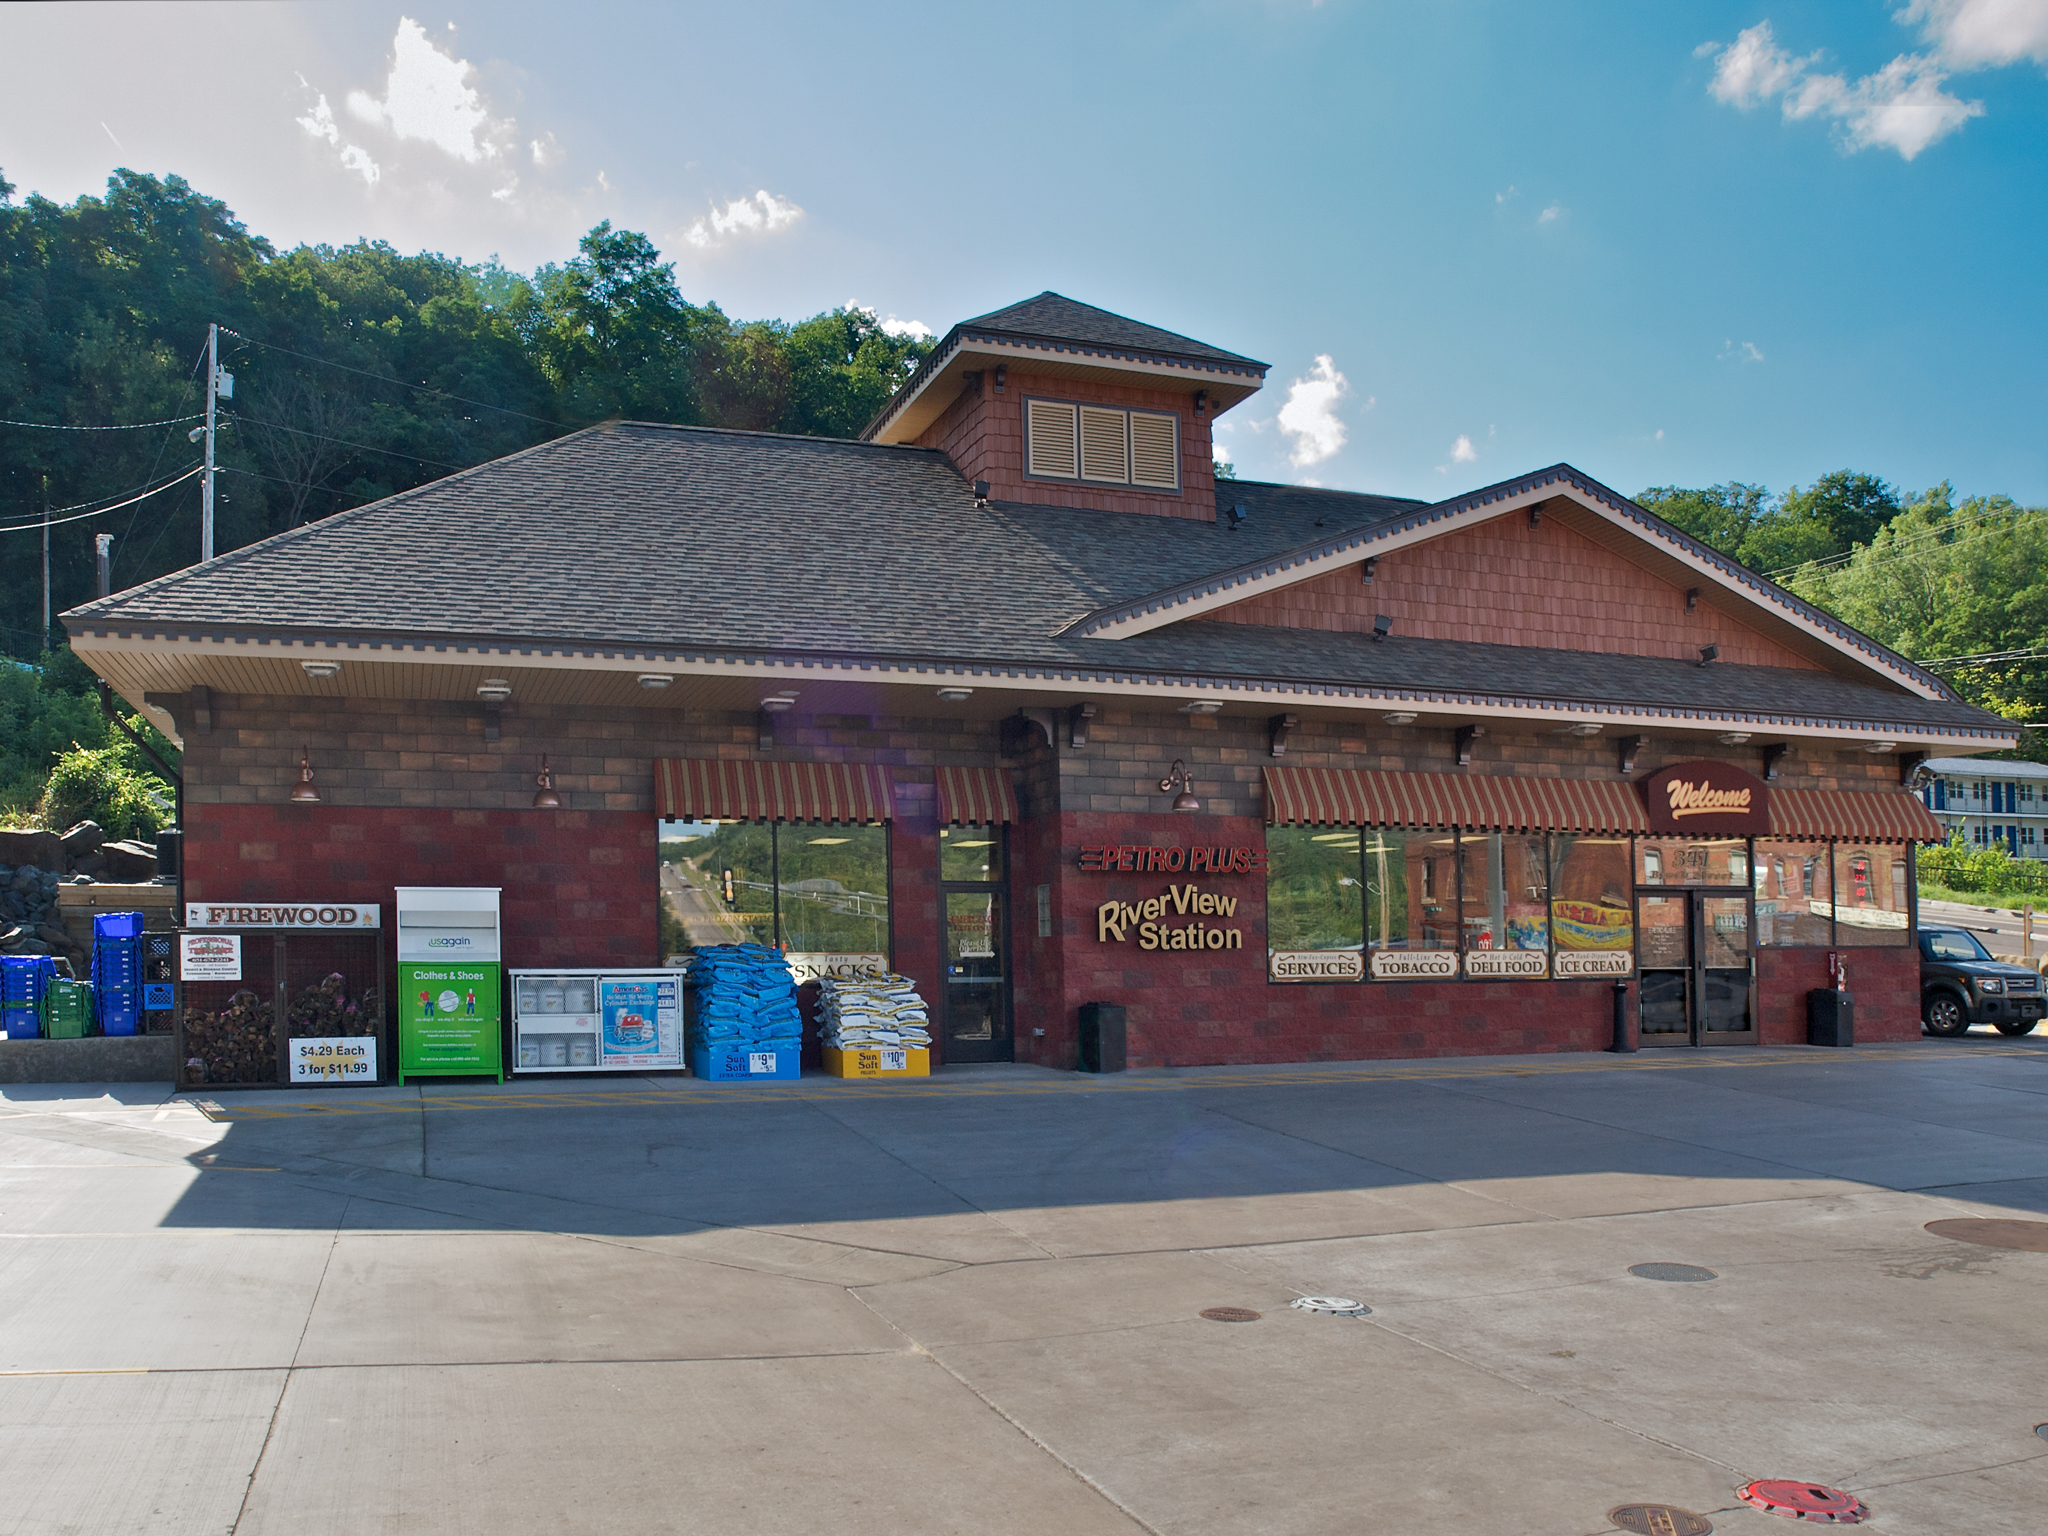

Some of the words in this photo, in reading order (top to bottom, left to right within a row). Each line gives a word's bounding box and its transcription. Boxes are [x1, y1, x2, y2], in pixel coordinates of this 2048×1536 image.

[1666, 778, 1752, 809] Welcome
[1100, 845, 1185, 872] PETRO
[1189, 846, 1251, 873] PLUS
[1673, 849, 1709, 868] 341
[206, 906, 358, 925] FIREWOOD
[1098, 884, 1238, 942] RiverView
[187, 936, 234, 947] PROFESSIONAL
[1139, 922, 1243, 951] Station
[824, 955, 849, 964] Tasty
[1398, 953, 1431, 961] Full-Line
[1489, 953, 1501, 961] Hot
[1501, 953, 1507, 961] &
[1509, 952, 1523, 961] Cold
[1575, 952, 1610, 960] Hand-Dipped
[794, 964, 878, 978] SNACKS
[1277, 962, 1358, 976] SERVICES
[1379, 962, 1450, 974] TOBACCO
[1470, 961, 1502, 974] DELI
[1504, 960, 1543, 973] FOOD
[1559, 961, 1580, 973] ICE
[1582, 960, 1627, 972] CREAM
[413, 970, 448, 980] Clothes
[449, 971, 456, 980] &
[457, 970, 484, 980] Shoes
[612, 985, 649, 993] AmeriGas
[300, 1045, 333, 1056] $4.29
[336, 1045, 365, 1056] Each
[726, 1054, 745, 1063] Sun
[858, 1052, 877, 1061] Sun
[298, 1064, 306, 1074] 3
[309, 1064, 326, 1074] for
[328, 1063, 368, 1074] $11.99
[725, 1063, 746, 1072] Soft
[858, 1061, 878, 1069] Soft
